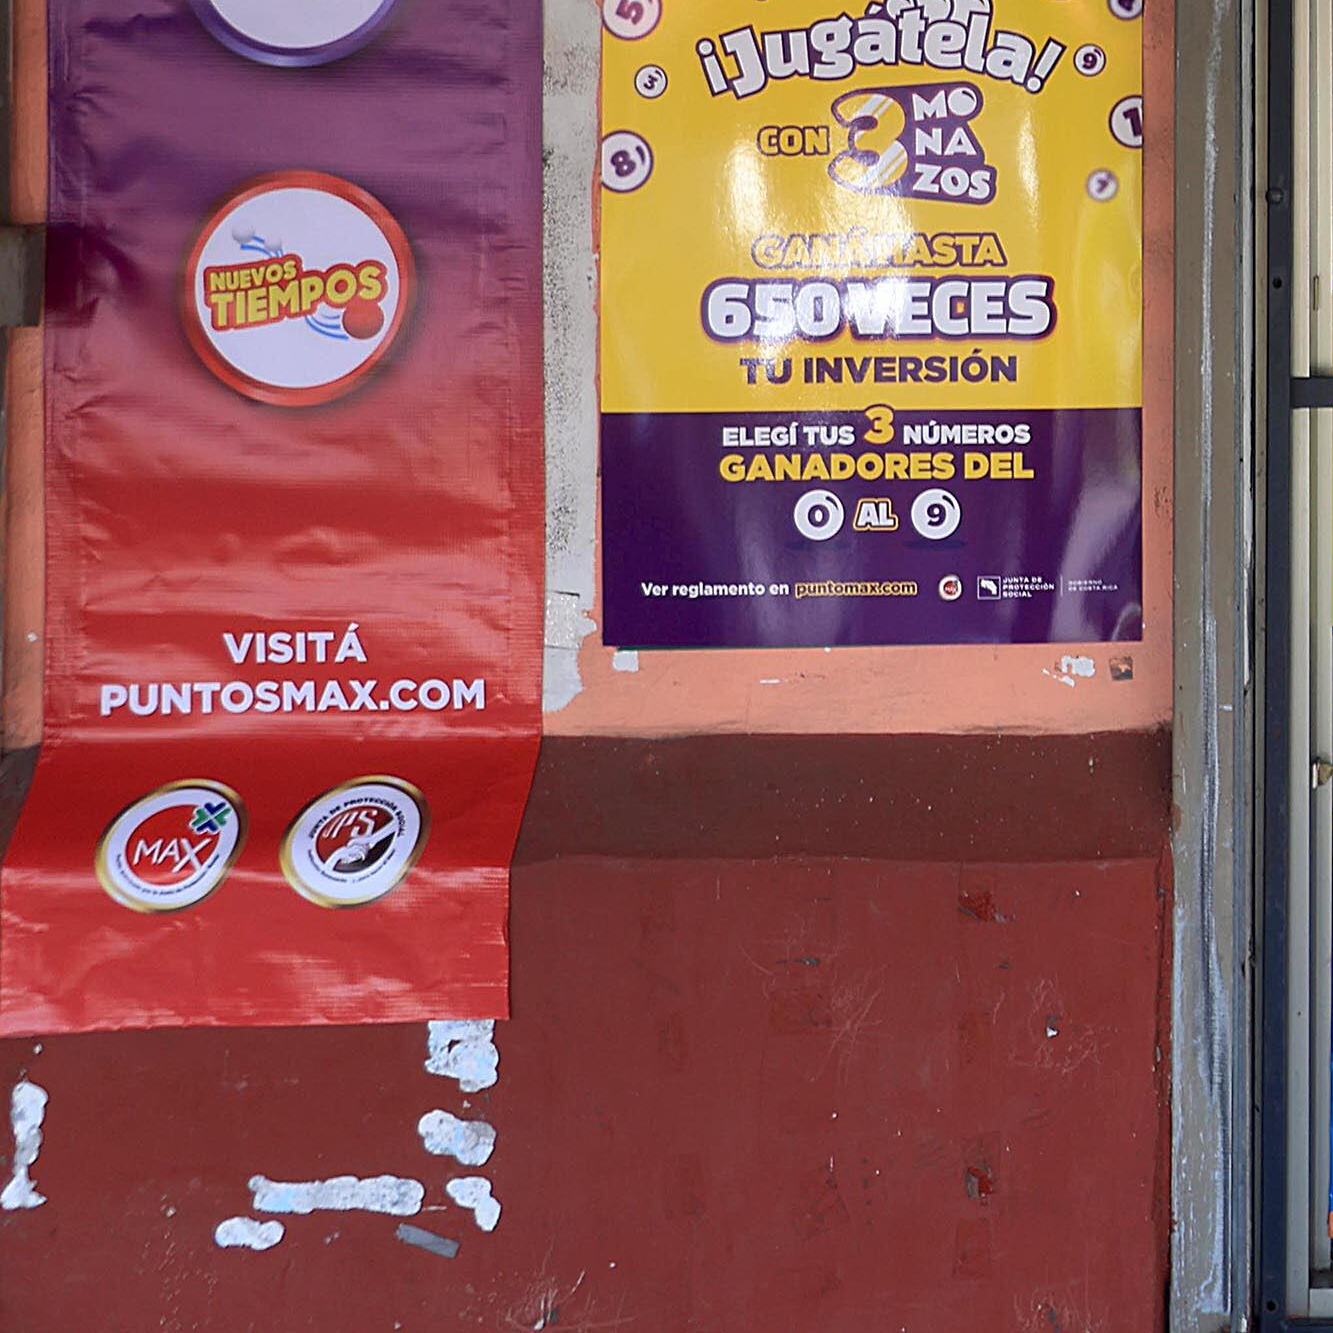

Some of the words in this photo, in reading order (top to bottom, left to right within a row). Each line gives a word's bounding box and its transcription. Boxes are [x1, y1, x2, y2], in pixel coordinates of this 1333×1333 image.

[696, 0, 1066, 98] ¡Jugátela!
[757, 126, 830, 156] CON
[828, 90, 908, 196] 3
[911, 163, 992, 198] ZOS
[209, 262, 298, 292] NUEVOS
[209, 265, 385, 327] TIEMPOS
[703, 276, 843, 342] 650
[846, 275, 1056, 341] VECES
[740, 357, 792, 384] TU
[804, 349, 1018, 384] INVERSIÓN
[722, 421, 798, 448] ELEGÍ
[803, 424, 855, 447] TUS
[863, 405, 896, 445] 3
[902, 421, 1032, 446] NÚMEROS
[719, 452, 956, 483] GANADORES
[963, 451, 1035, 480] DEL
[853, 498, 898, 531] AL
[641, 581, 668, 597] Ver
[672, 580, 766, 600] reglamento
[769, 585, 790, 596] en
[794, 580, 918, 600] puntomax.com
[223, 623, 367, 665] VISITÁ
[99, 677, 487, 717] PUNTOSMAX.COM
[133, 837, 212, 874] MAX
